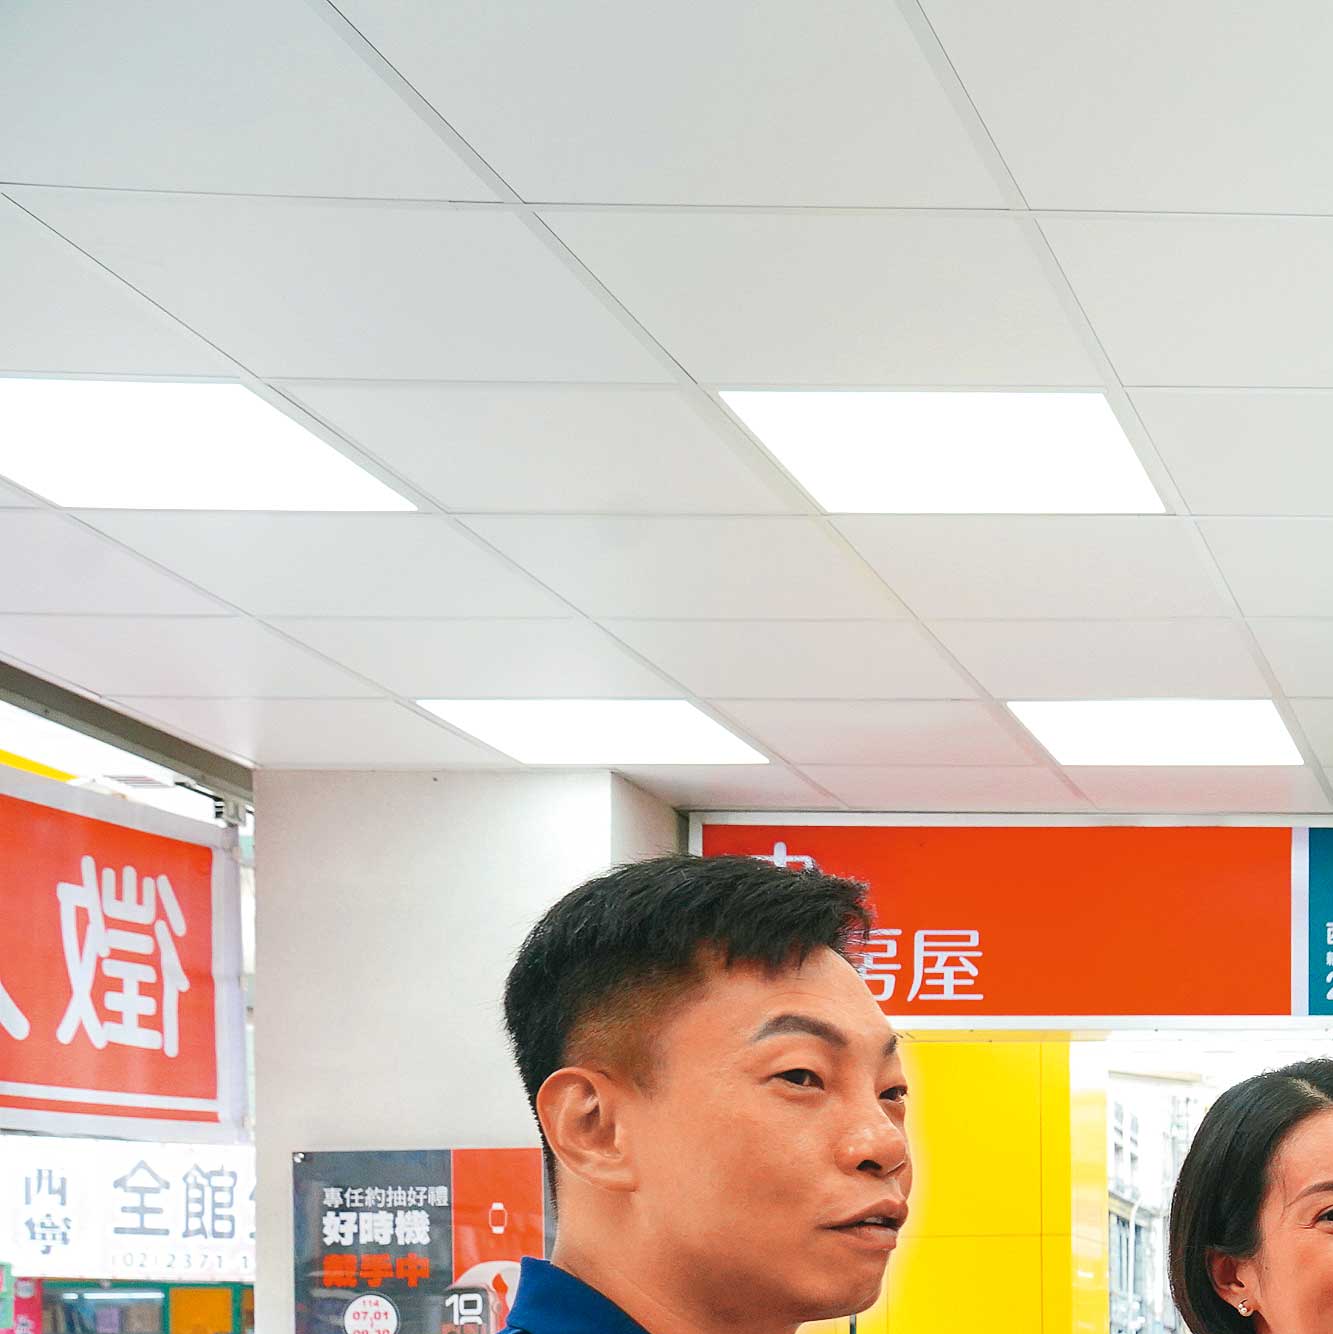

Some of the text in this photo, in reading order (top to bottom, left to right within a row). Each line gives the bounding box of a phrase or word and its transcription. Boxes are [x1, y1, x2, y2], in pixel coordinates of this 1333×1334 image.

[112, 1160, 255, 1238] 全館
[322, 1186, 449, 1208] 專任約抽好禮
[322, 1210, 431, 1247] 好時機
